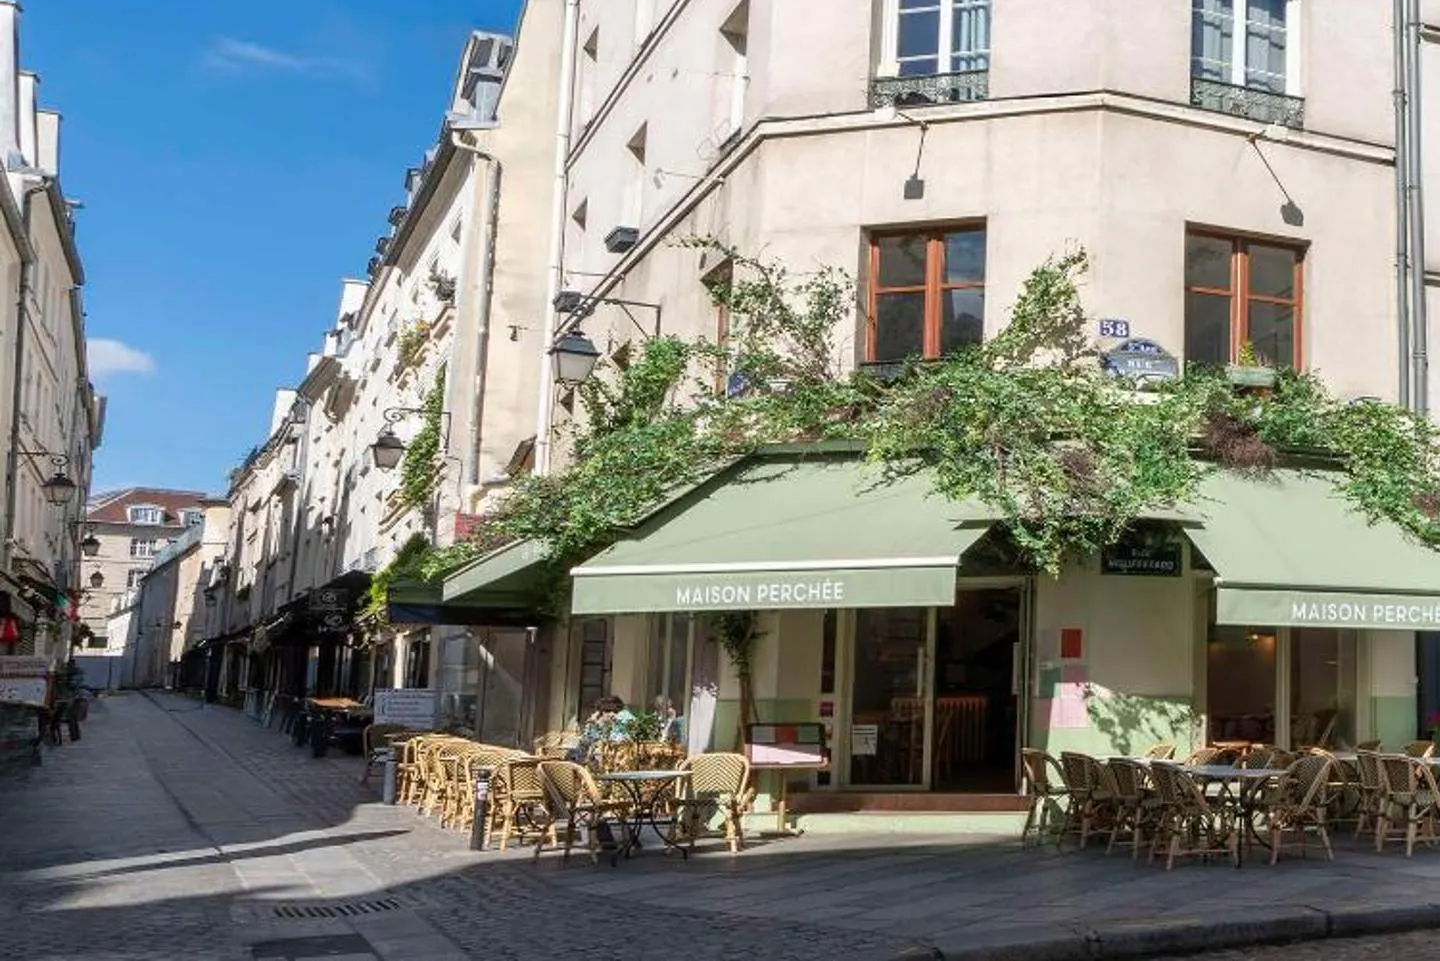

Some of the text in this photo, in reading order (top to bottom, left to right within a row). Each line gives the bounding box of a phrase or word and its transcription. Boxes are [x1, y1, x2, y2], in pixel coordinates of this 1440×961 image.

[1102, 321, 1128, 336] 58
[676, 578, 845, 605] MAISON PERCHÉE
[1291, 602, 1366, 621] MAISON
